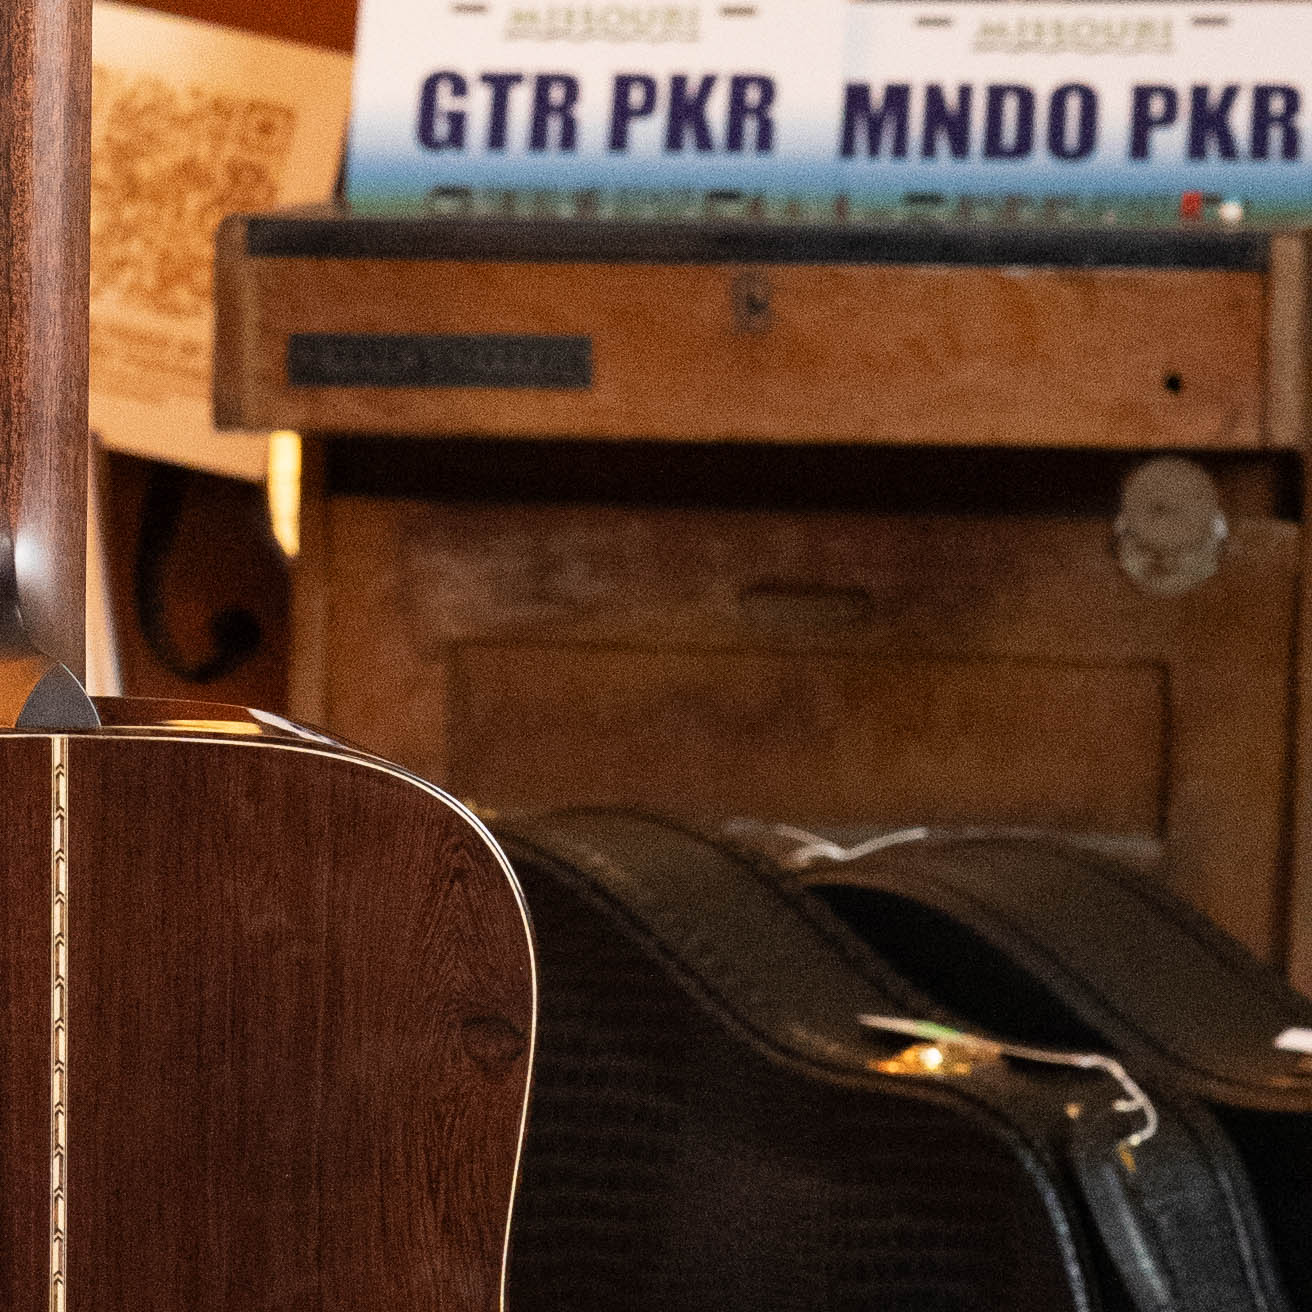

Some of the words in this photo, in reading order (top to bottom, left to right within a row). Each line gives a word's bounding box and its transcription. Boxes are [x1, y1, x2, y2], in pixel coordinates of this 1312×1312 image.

[416, 69, 581, 154] GTR
[607, 71, 777, 154] PKR
[839, 80, 1100, 162] MNDO
[1128, 83, 1302, 163] PKR
